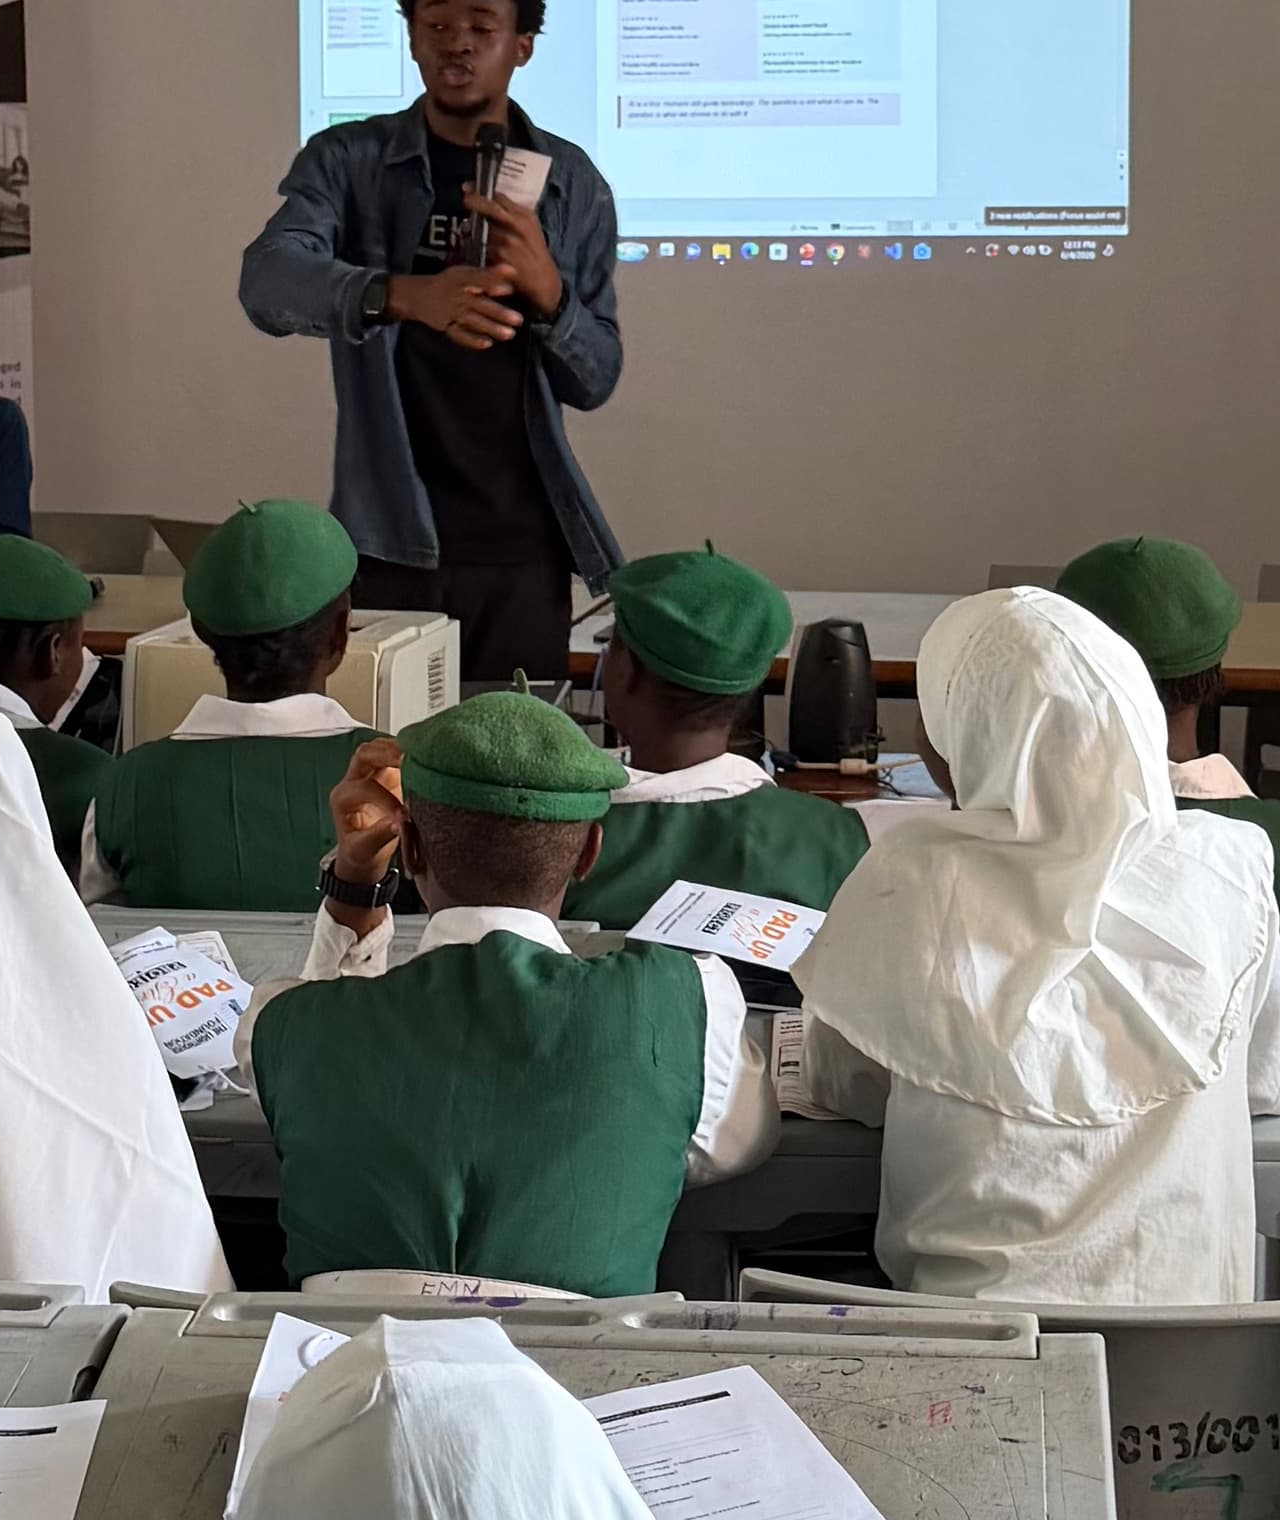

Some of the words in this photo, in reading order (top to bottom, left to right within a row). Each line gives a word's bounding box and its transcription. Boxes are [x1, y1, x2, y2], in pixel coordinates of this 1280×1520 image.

[761, 908, 799, 941] PAD
[746, 939, 777, 960] UP
[175, 978, 235, 1009] PAD
